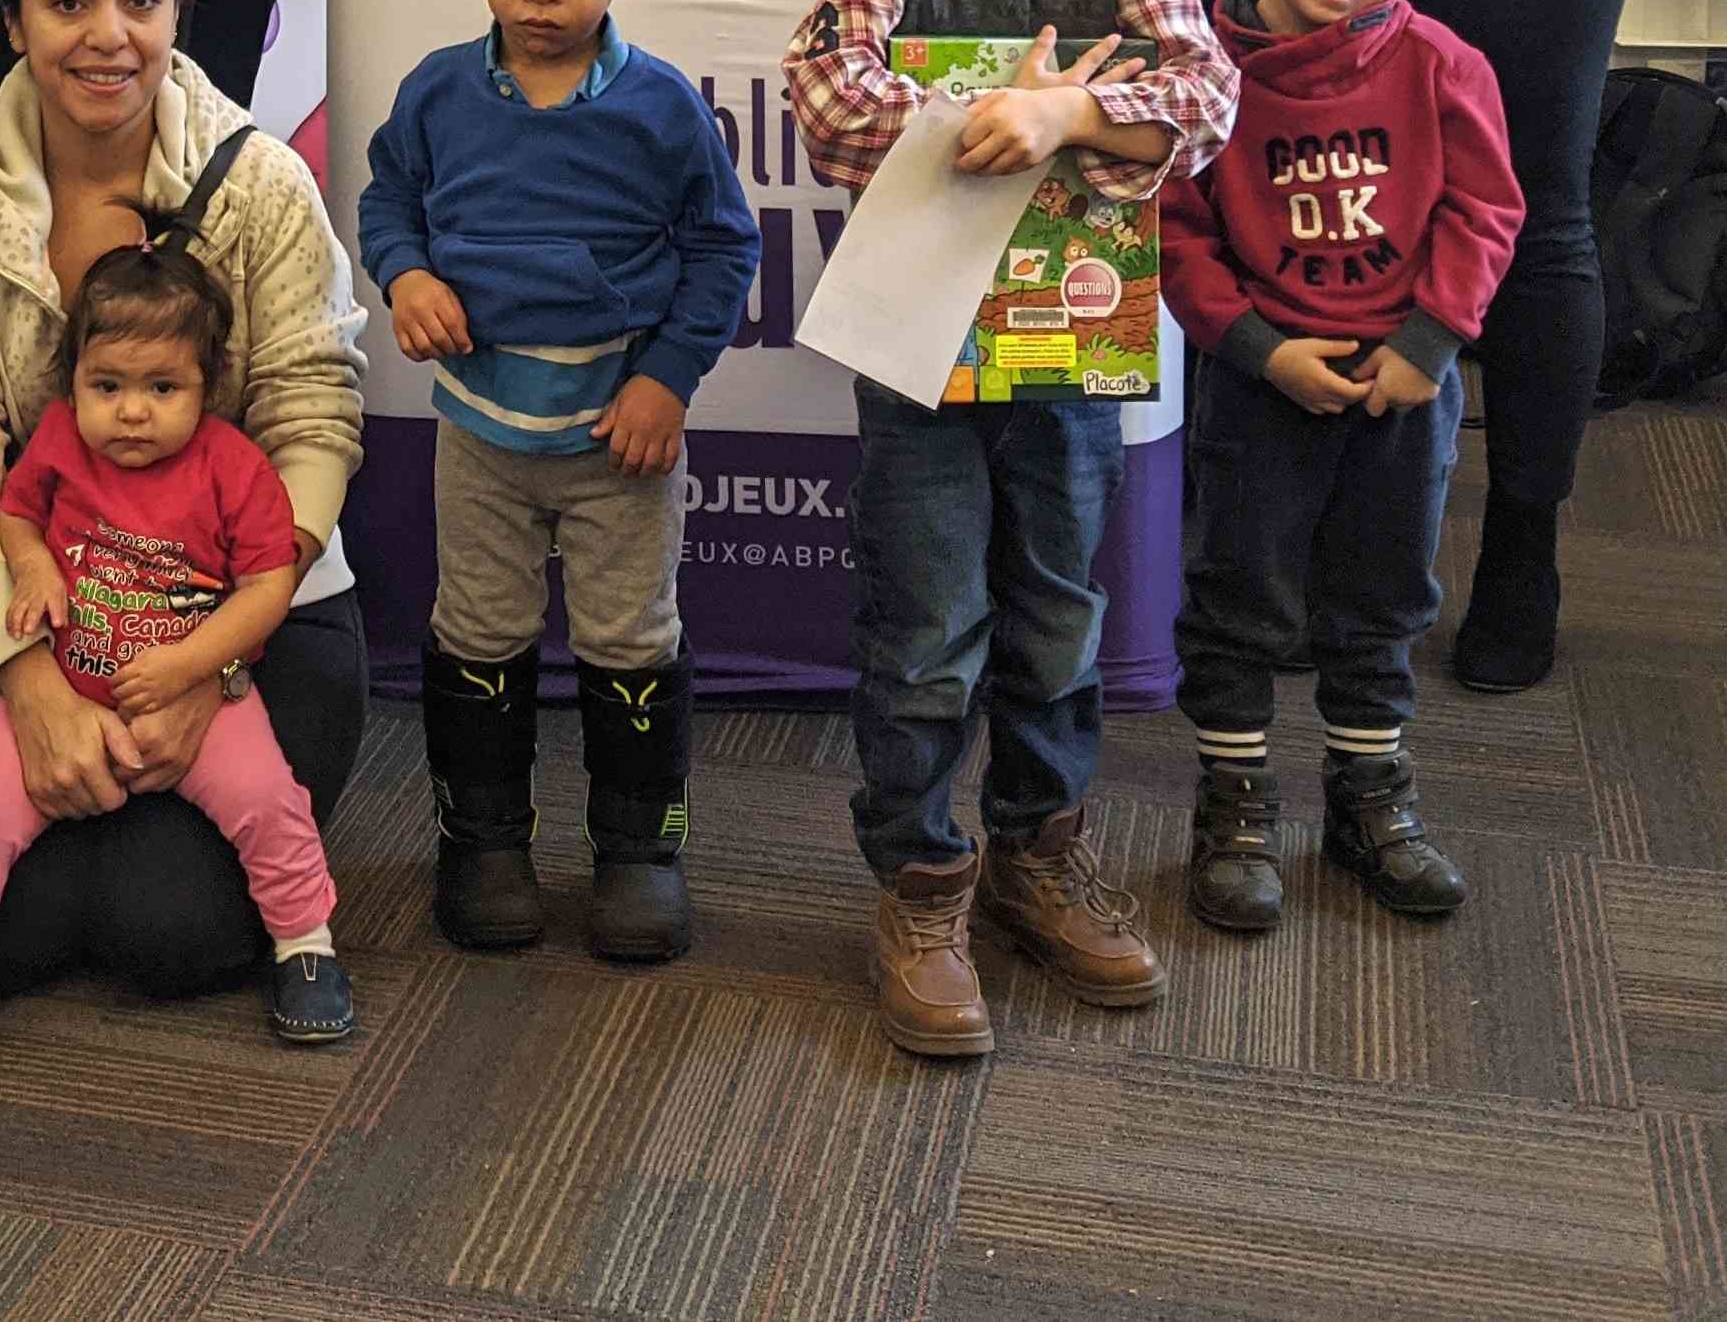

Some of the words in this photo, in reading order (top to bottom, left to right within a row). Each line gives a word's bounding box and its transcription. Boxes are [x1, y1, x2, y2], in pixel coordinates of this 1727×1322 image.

[1289, 185, 1385, 241] O.K
[1273, 238, 1403, 287] TEAM
[1067, 281, 1112, 297] QUESTIONS
[76, 575, 170, 613] Niagara
[71, 629, 113, 654] and
[64, 645, 119, 678] this
